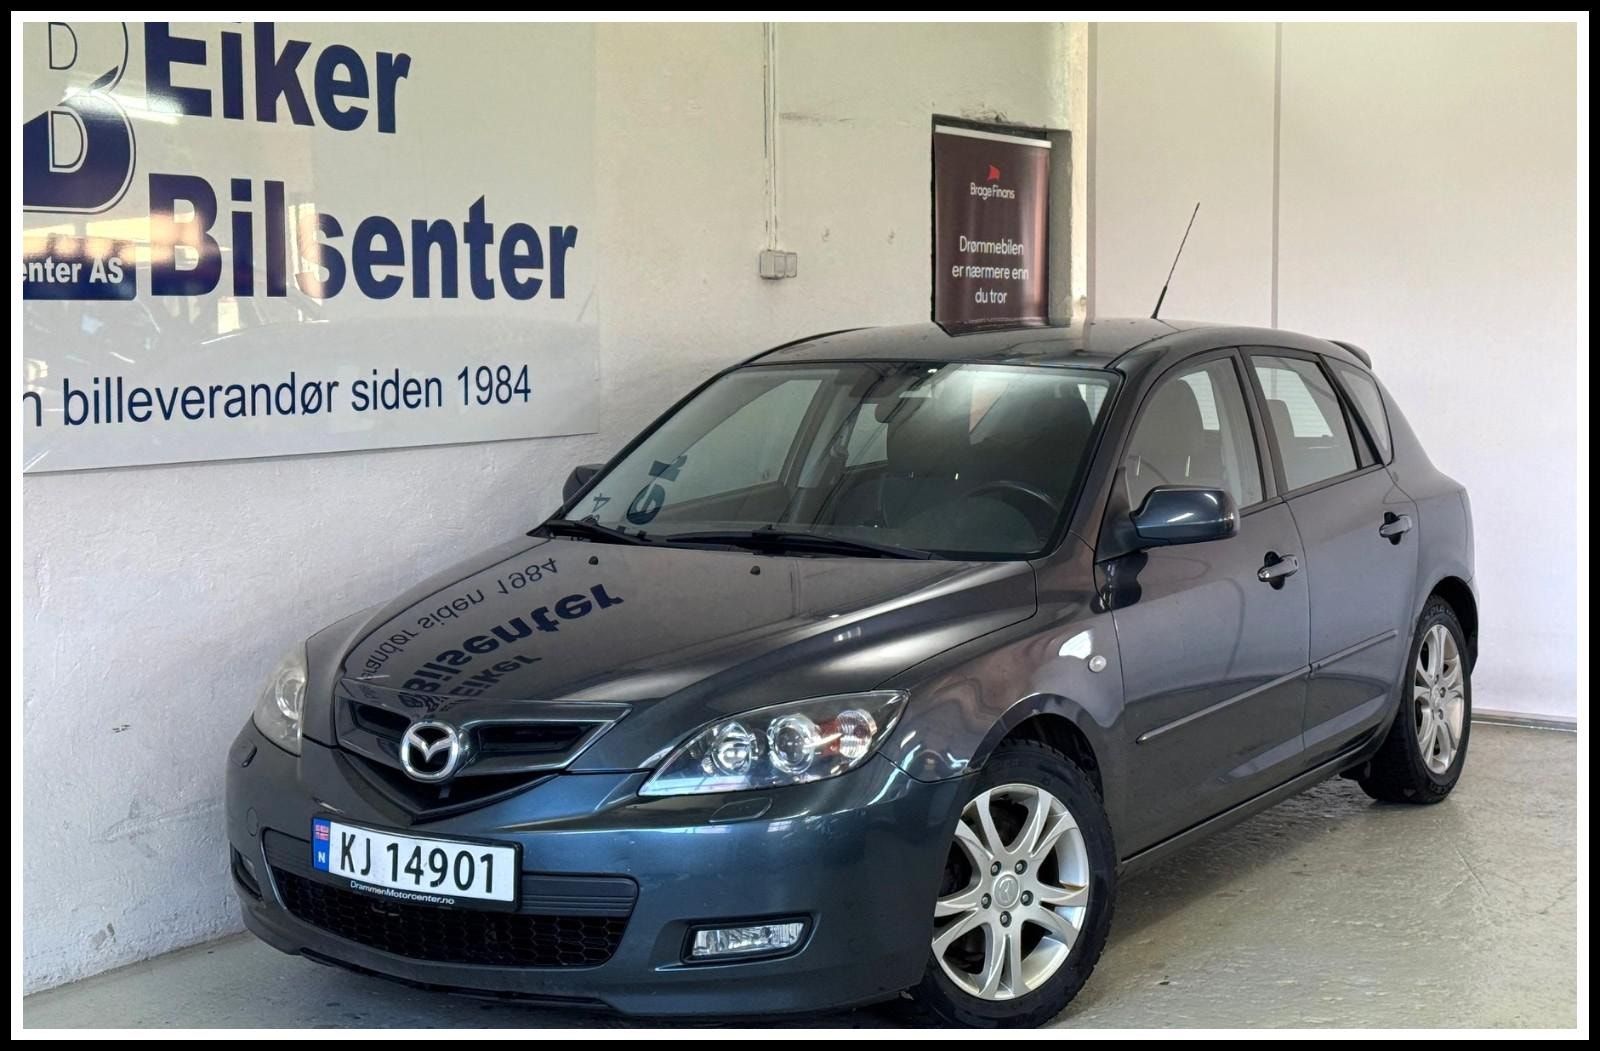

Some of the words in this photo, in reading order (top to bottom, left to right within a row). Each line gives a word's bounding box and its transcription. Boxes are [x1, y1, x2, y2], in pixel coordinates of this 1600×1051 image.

[145, 22, 412, 134] Eiker
[970, 182, 992, 200] Brage
[993, 184, 1016, 199] Finans
[148, 172, 578, 300] Bilsenter
[959, 235, 1025, 256] Drømmebilen
[89, 257, 124, 283] AS
[952, 265, 964, 277] er
[966, 265, 1010, 279] nærmere
[1012, 268, 1029, 280] enn
[975, 287, 988, 303] du
[990, 289, 1007, 304] tror
[63, 371, 339, 426] billeverandør
[351, 368, 443, 411] siden
[457, 364, 532, 406] 1984
[317, 851, 327, 864] N
[340, 832, 371, 876] KJ
[387, 842, 493, 894] 14901
[350, 880, 455, 905] DrammenMotorcenter.no
